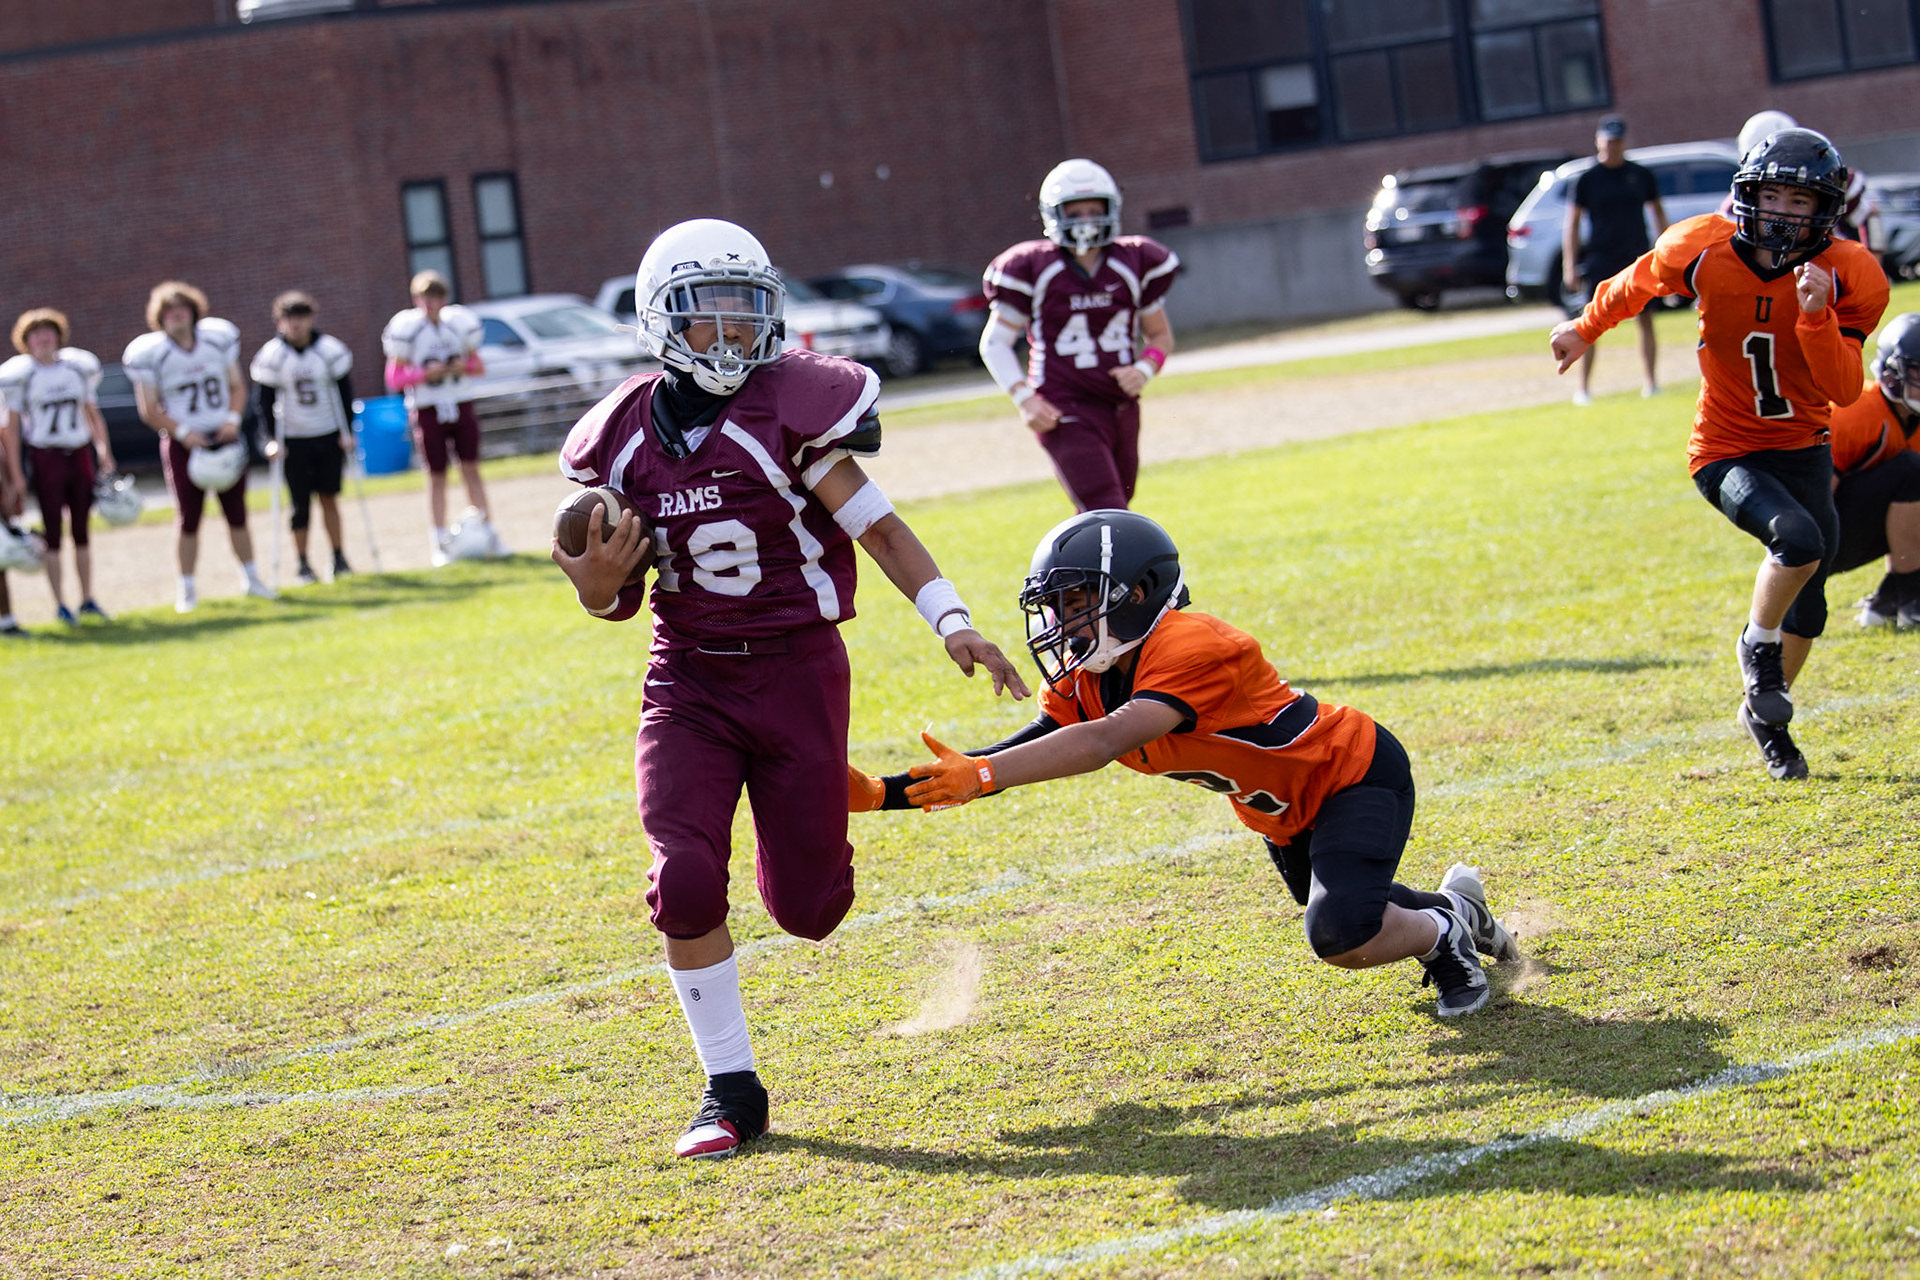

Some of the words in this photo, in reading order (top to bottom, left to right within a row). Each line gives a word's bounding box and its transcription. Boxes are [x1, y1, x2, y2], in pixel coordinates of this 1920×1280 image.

[1756, 296, 1773, 323] U
[1054, 309, 1133, 369] 44
[295, 378, 317, 406] 5
[1742, 331, 1794, 419] 1
[177, 376, 222, 413] 78
[657, 485, 723, 518] RAMS
